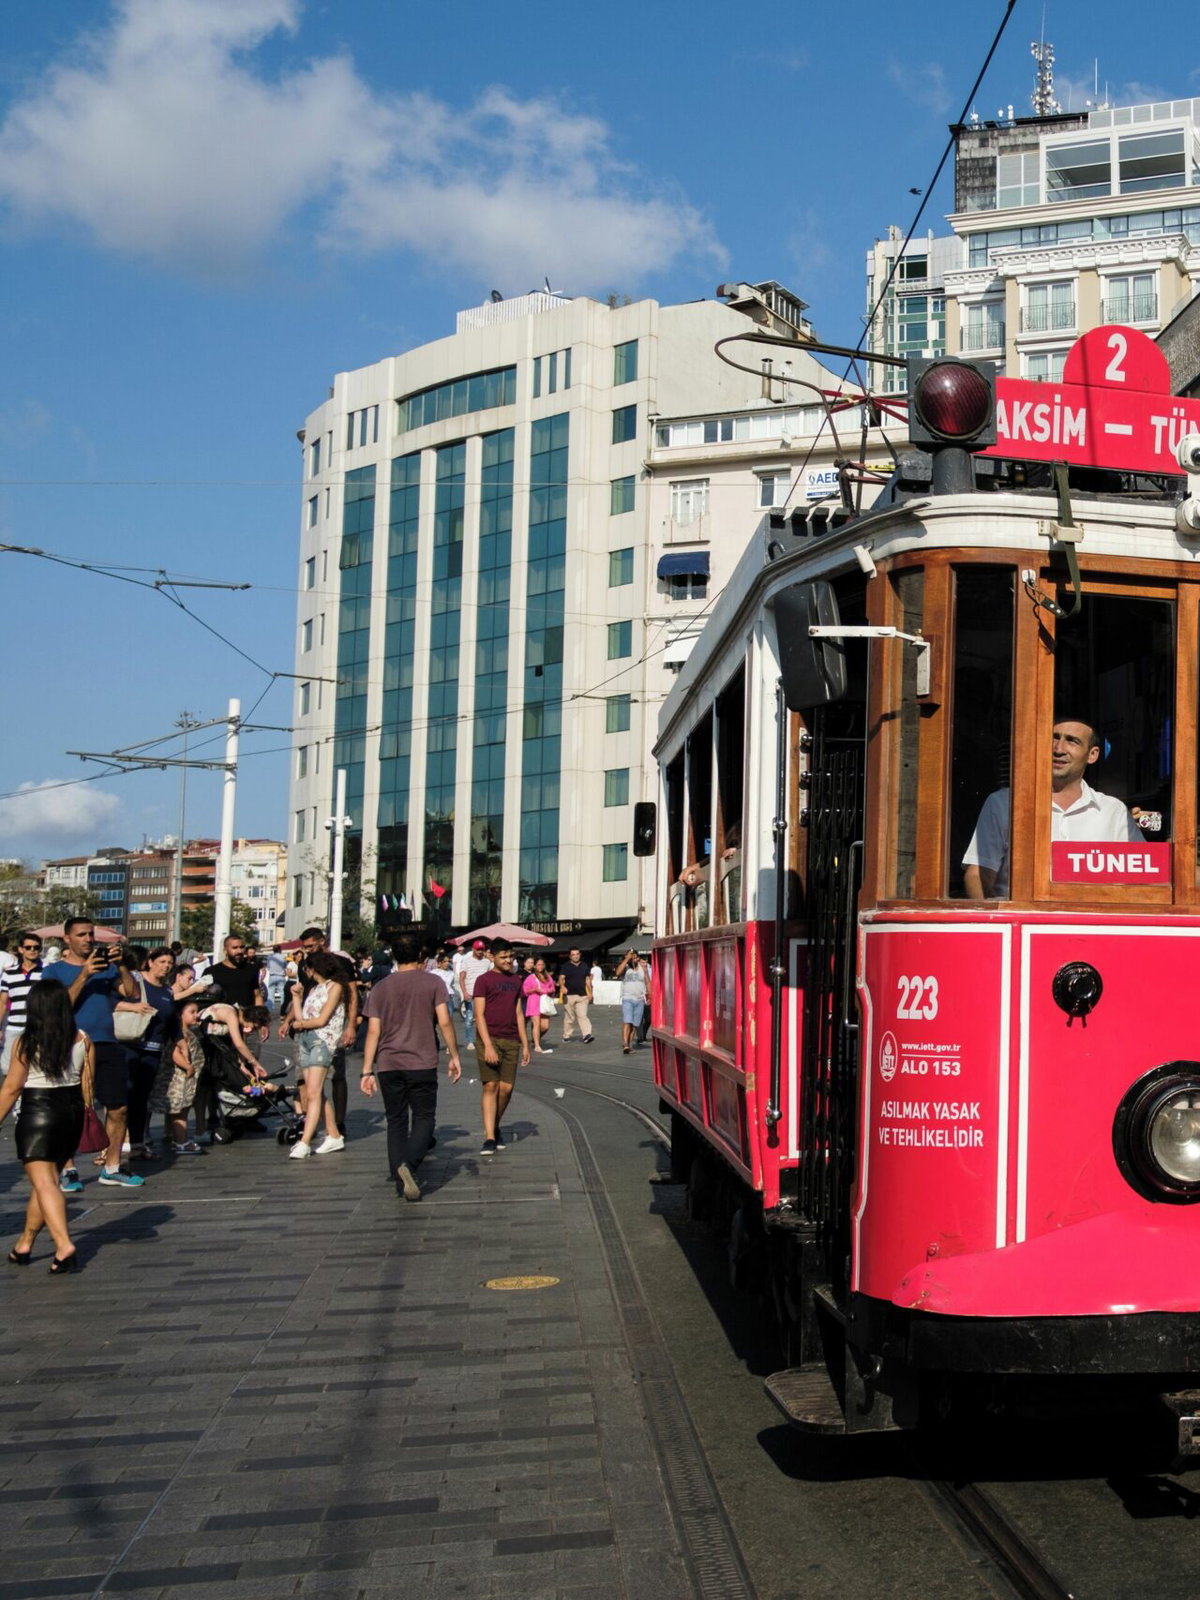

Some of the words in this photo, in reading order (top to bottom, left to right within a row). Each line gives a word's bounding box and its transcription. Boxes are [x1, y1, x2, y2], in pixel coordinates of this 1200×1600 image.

[1105, 333, 1127, 382] 2
[995, 394, 1086, 447] AKSİM
[1067, 849, 1159, 873] TÜNEL
[897, 976, 938, 1020] 223
[901, 1043, 961, 1052] www.iett.gov.tr
[901, 1060, 929, 1075] ALO
[933, 1061, 961, 1076] 153
[881, 1101, 930, 1119] ASILMAK
[933, 1102, 980, 1120] YASAK
[879, 1127, 890, 1144] VE
[892, 1125, 983, 1147] TEHLİKELİDİR
